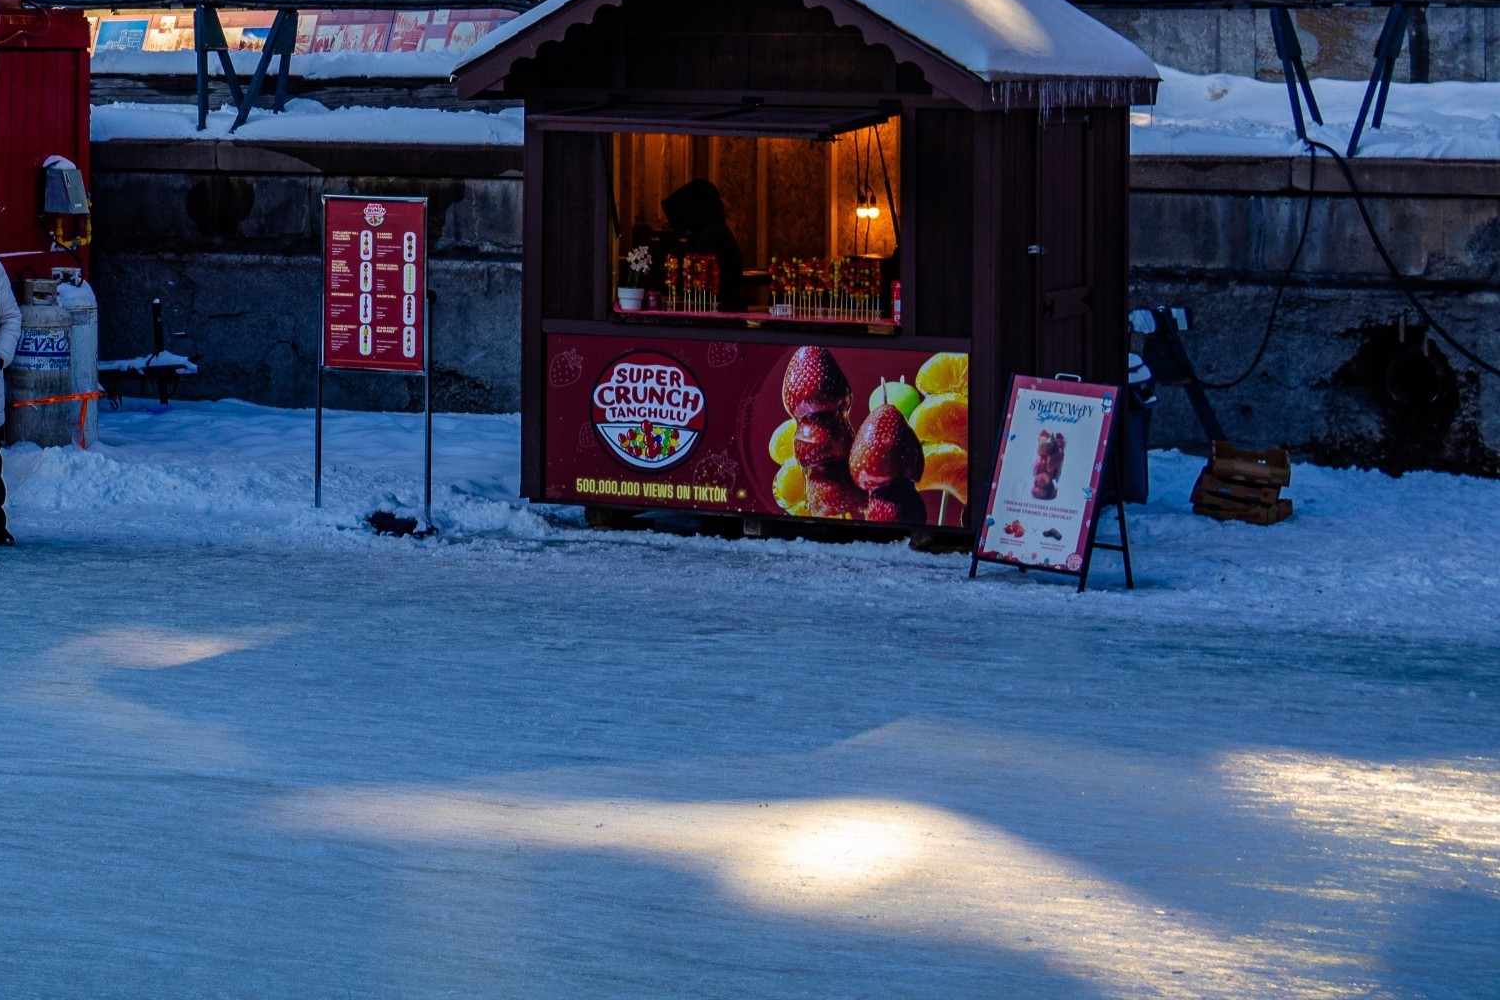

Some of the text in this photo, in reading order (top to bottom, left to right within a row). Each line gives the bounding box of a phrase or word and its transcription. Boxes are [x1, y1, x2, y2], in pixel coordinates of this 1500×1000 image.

[615, 367, 682, 388] SUPER
[597, 385, 700, 412] CRUNCH
[1029, 399, 1094, 417] SKATEWAY
[609, 406, 687, 422] TANGHULU
[576, 478, 728, 503] 500,000,000 VIEWS ON TIKTOK
